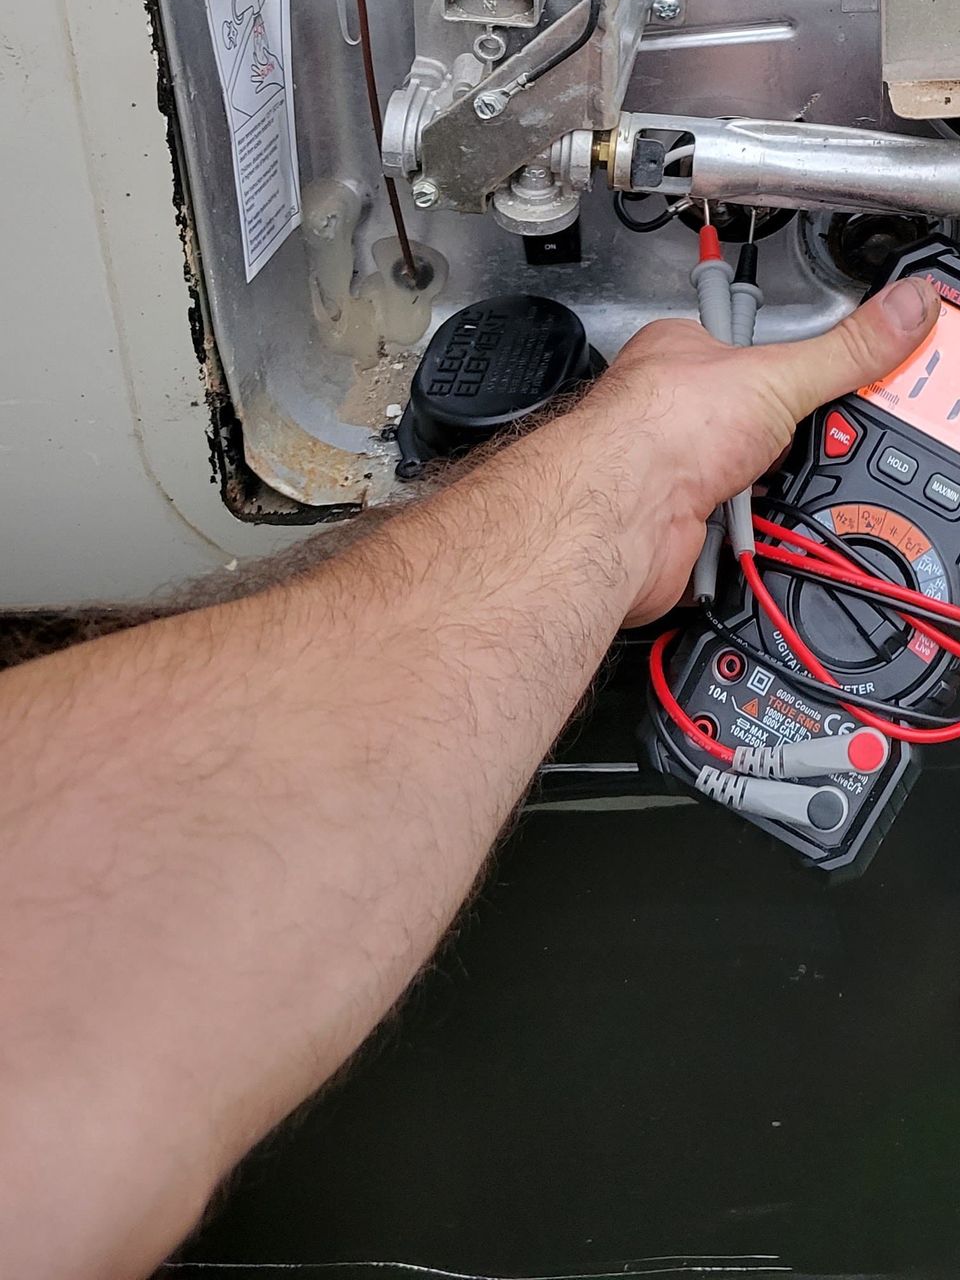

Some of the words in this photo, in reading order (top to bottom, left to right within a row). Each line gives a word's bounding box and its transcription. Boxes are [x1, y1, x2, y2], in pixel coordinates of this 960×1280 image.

[427, 309, 484, 397] ELECTRIC
[454, 309, 509, 398] ELEMENT
[829, 427, 851, 446] FUNC.
[886, 455, 910, 474] HOLD
[931, 479, 960, 503] MAX/MIN
[915, 642, 931, 656] Live
[708, 684, 728, 704] 10A
[776, 688, 796, 704] 6000
[795, 698, 822, 721] Counts
[764, 706, 787, 723] 1000V
[784, 717, 801, 731] CAT
[798, 726, 808, 737] III
[767, 695, 797, 719] TRUE
[796, 713, 822, 733] RMS
[730, 724, 767, 748] 10A/250V
[749, 724, 769, 741] MAX
[762, 715, 781, 730] 600V
[779, 724, 796, 738] CAT
[833, 774, 848, 788] Live
